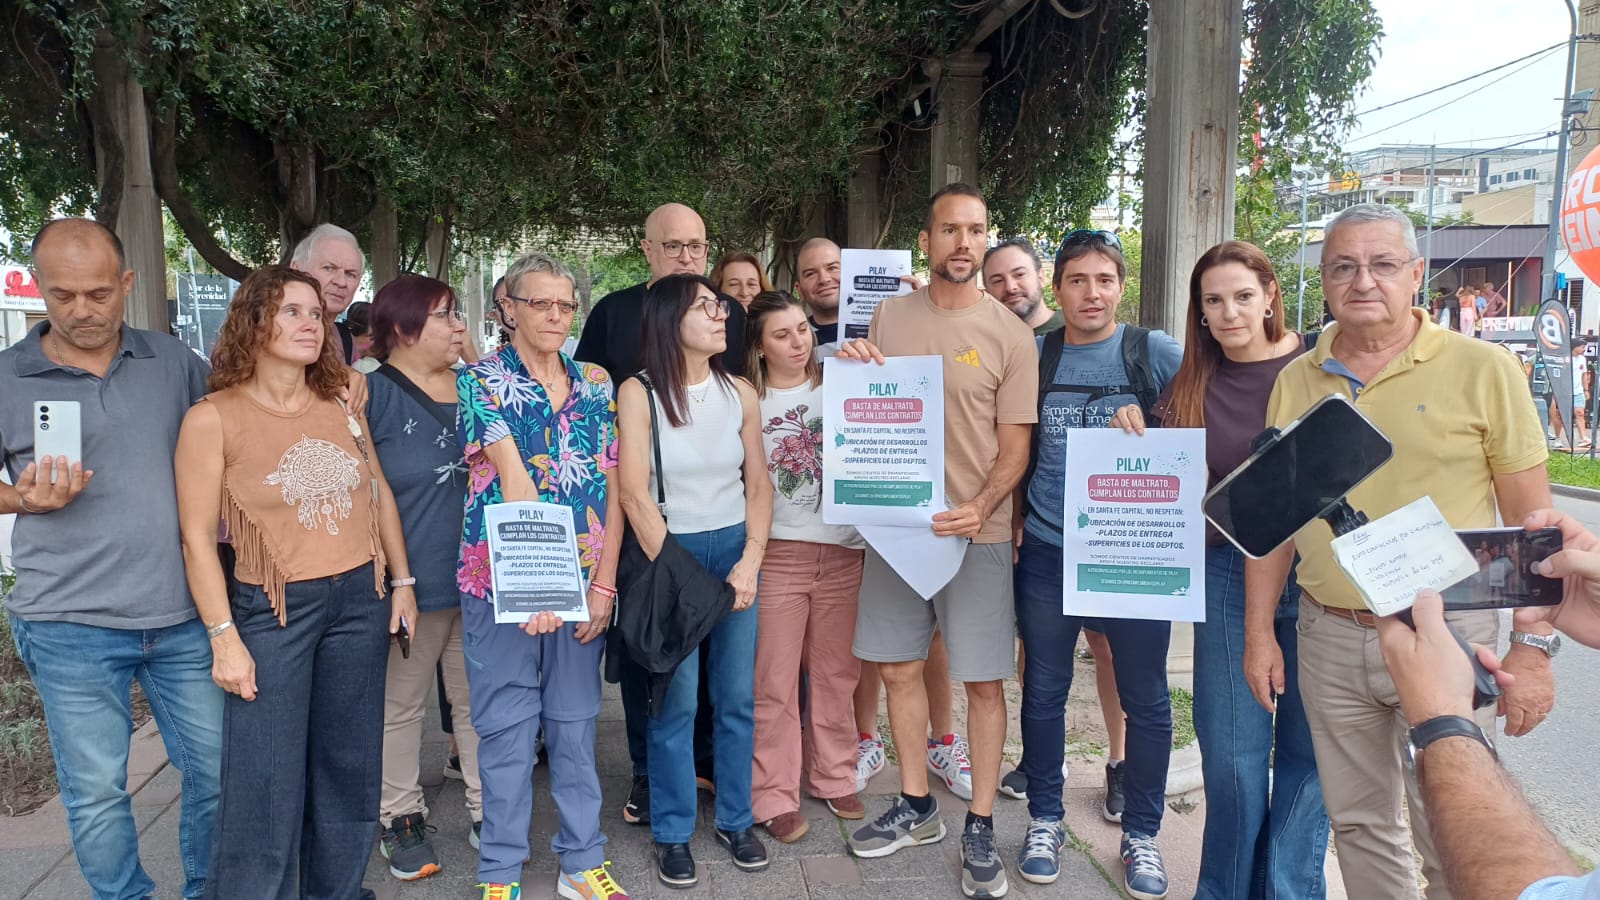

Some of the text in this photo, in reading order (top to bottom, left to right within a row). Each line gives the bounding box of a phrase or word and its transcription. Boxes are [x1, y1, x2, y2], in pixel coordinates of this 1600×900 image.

[1483, 317, 1534, 331] PREMIU
[869, 383, 898, 396] PILAY
[1105, 405, 1114, 414] is
[1048, 413, 1111, 425] the ulima
[1117, 458, 1150, 471] PILAY
[1090, 489, 1178, 498] CUMPLAN LOS CONTRATOS
[519, 509, 544, 520] PILAY
